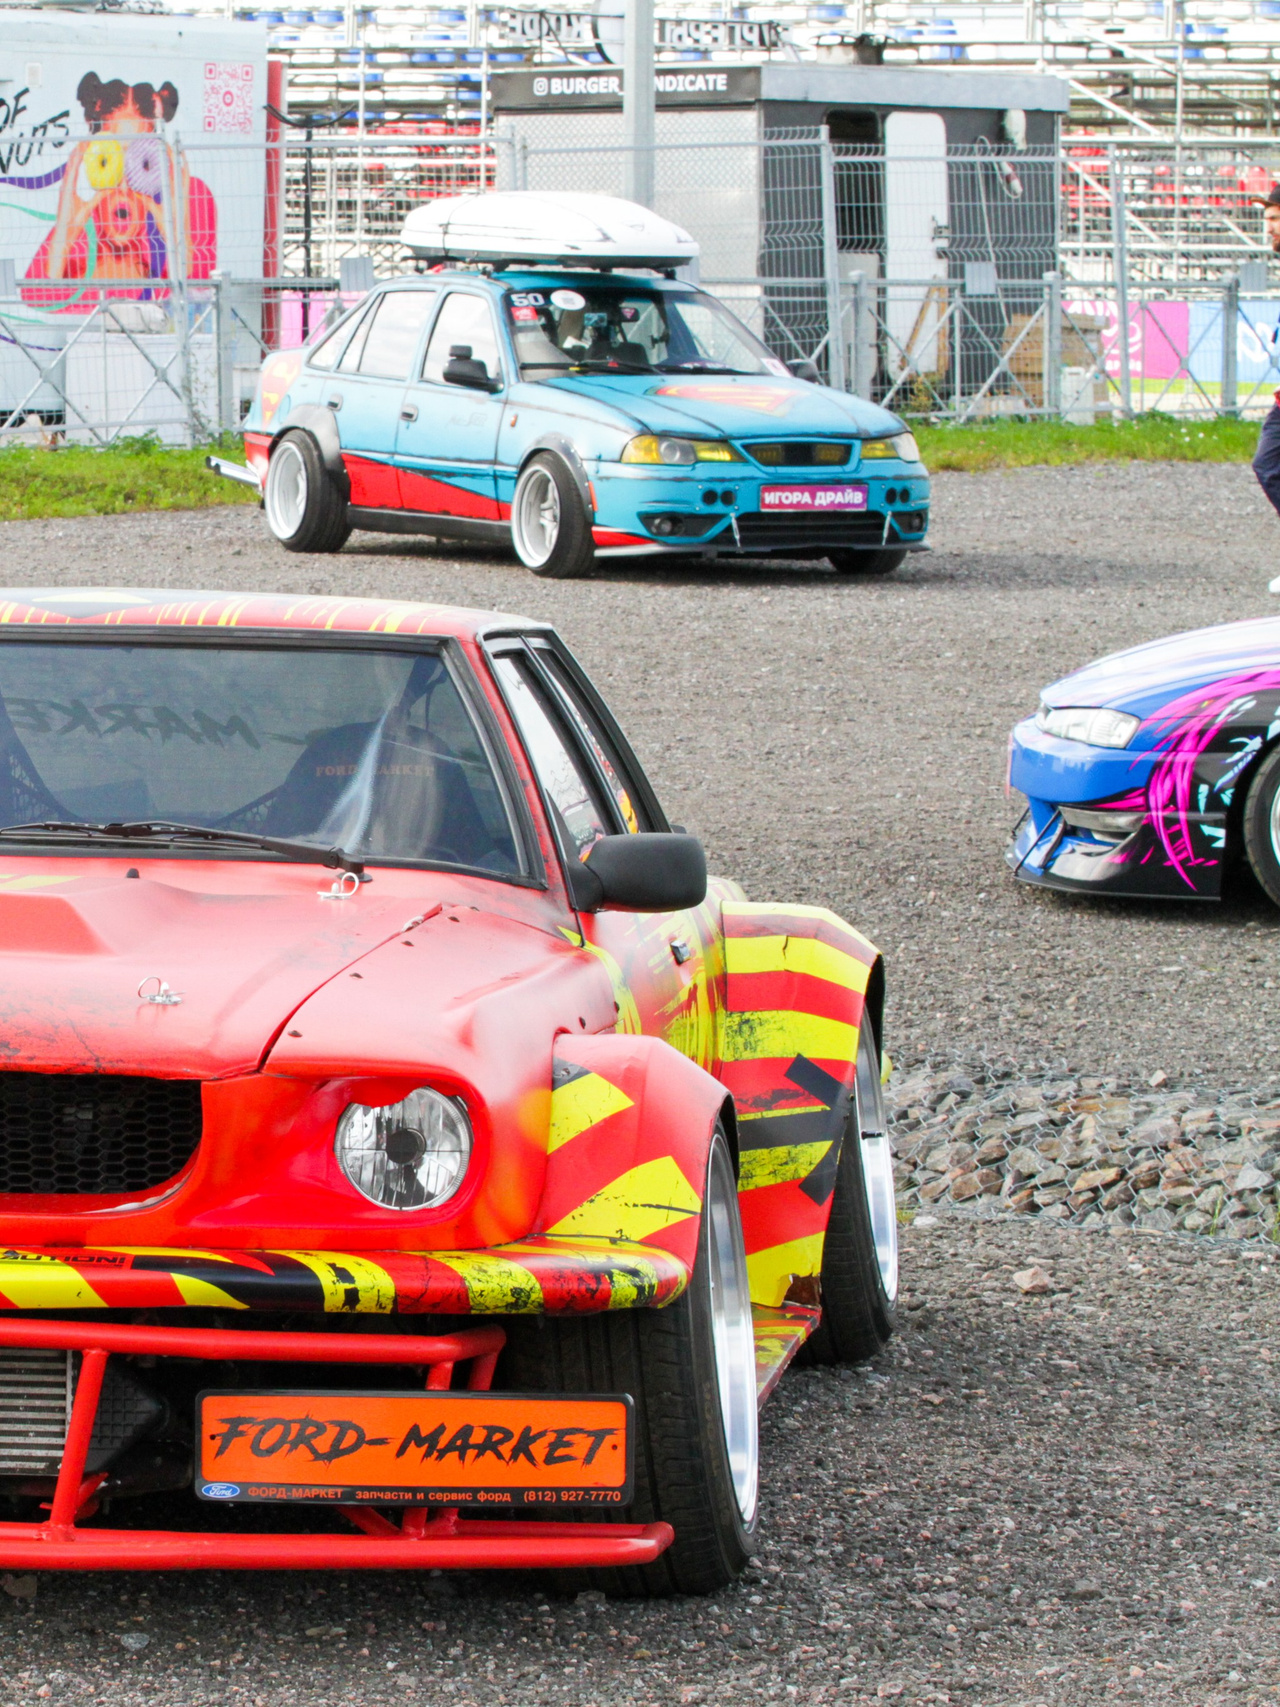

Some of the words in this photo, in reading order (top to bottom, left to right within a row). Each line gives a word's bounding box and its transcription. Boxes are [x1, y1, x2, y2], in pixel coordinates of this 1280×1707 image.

[550, 73, 728, 96] BURGER_NDICATE
[510, 292, 545, 307] 50
[764, 491, 812, 505] ИГОРА
[814, 488, 863, 506] ДРАЙВ
[248, 1486, 343, 1500] ФОРД-МАРКЕТ
[355, 1491, 412, 1500] запчасти
[417, 1491, 424, 1500] и
[428, 1491, 473, 1502] сервис
[477, 1490, 511, 1502] форд
[524, 1491, 556, 1503] (812)
[561, 1491, 621, 1502] 927-7770
